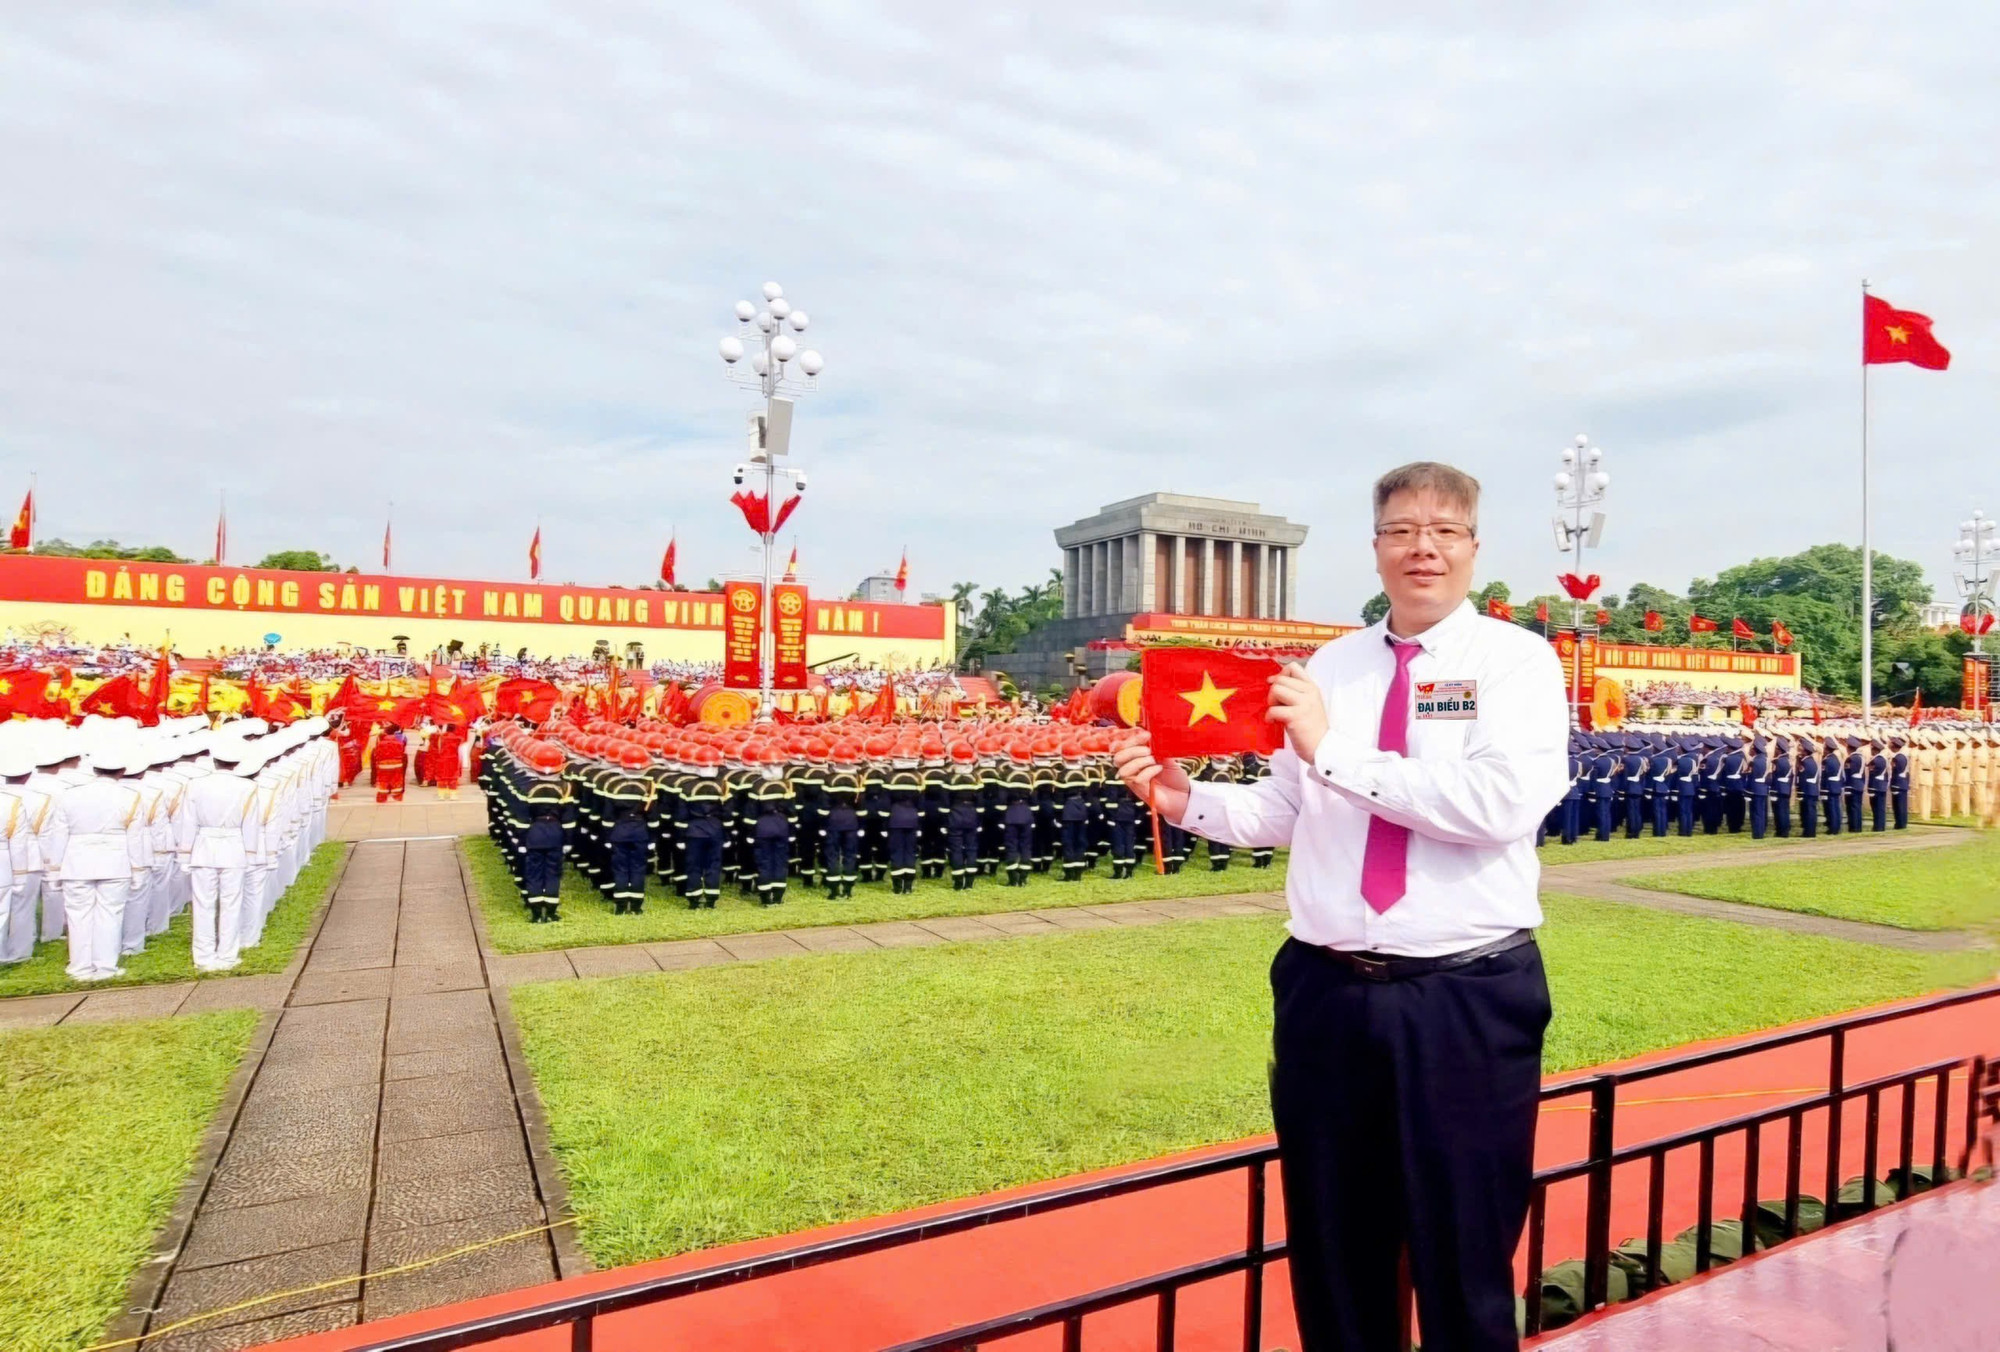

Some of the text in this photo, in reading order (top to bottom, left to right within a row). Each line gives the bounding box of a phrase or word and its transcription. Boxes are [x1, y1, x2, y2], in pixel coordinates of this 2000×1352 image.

[86, 566, 185, 602] ĐẢNG
[207, 574, 299, 610] CỘNG
[318, 577, 380, 610] SẢN
[398, 584, 466, 618] VIỆT
[483, 590, 543, 618] NAM
[559, 594, 649, 623] QUANG
[664, 599, 724, 626] VINH
[1418, 702, 1434, 714] ĐẠI
[1437, 697, 1459, 711] BIỂU
[1462, 701, 1475, 711] B2
